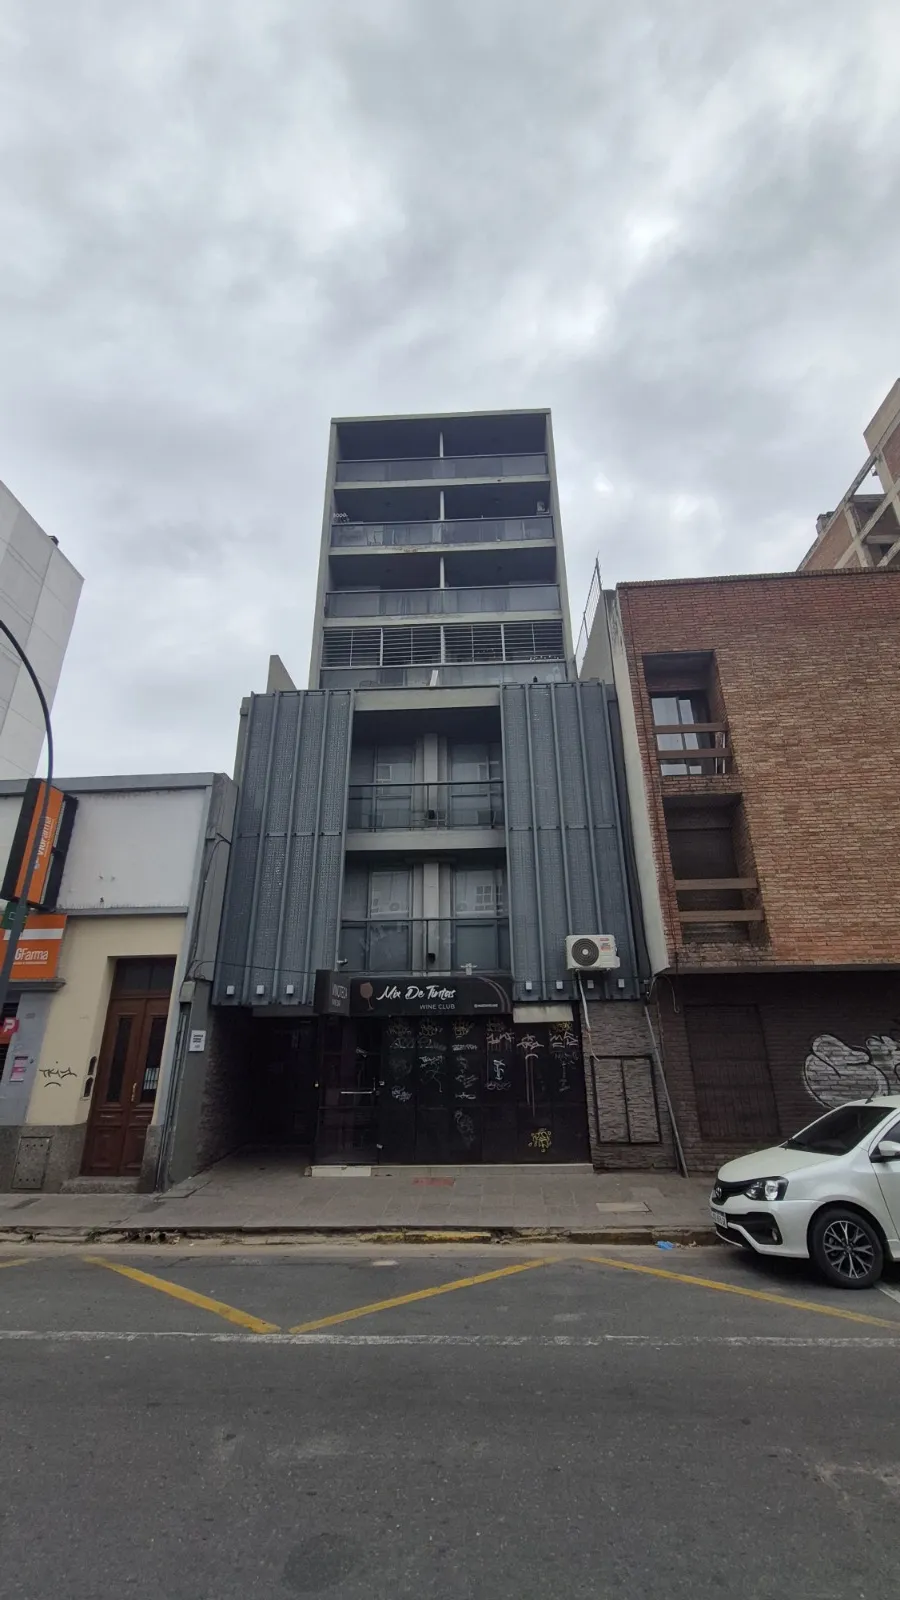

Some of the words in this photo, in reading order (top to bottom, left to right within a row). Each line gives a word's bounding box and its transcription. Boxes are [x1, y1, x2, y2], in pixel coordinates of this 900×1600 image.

[14, 947, 49, 961] GFarma
[376, 985, 401, 1000] Mix
[404, 985, 425, 1000] De
[425, 984, 457, 1000] Tintas
